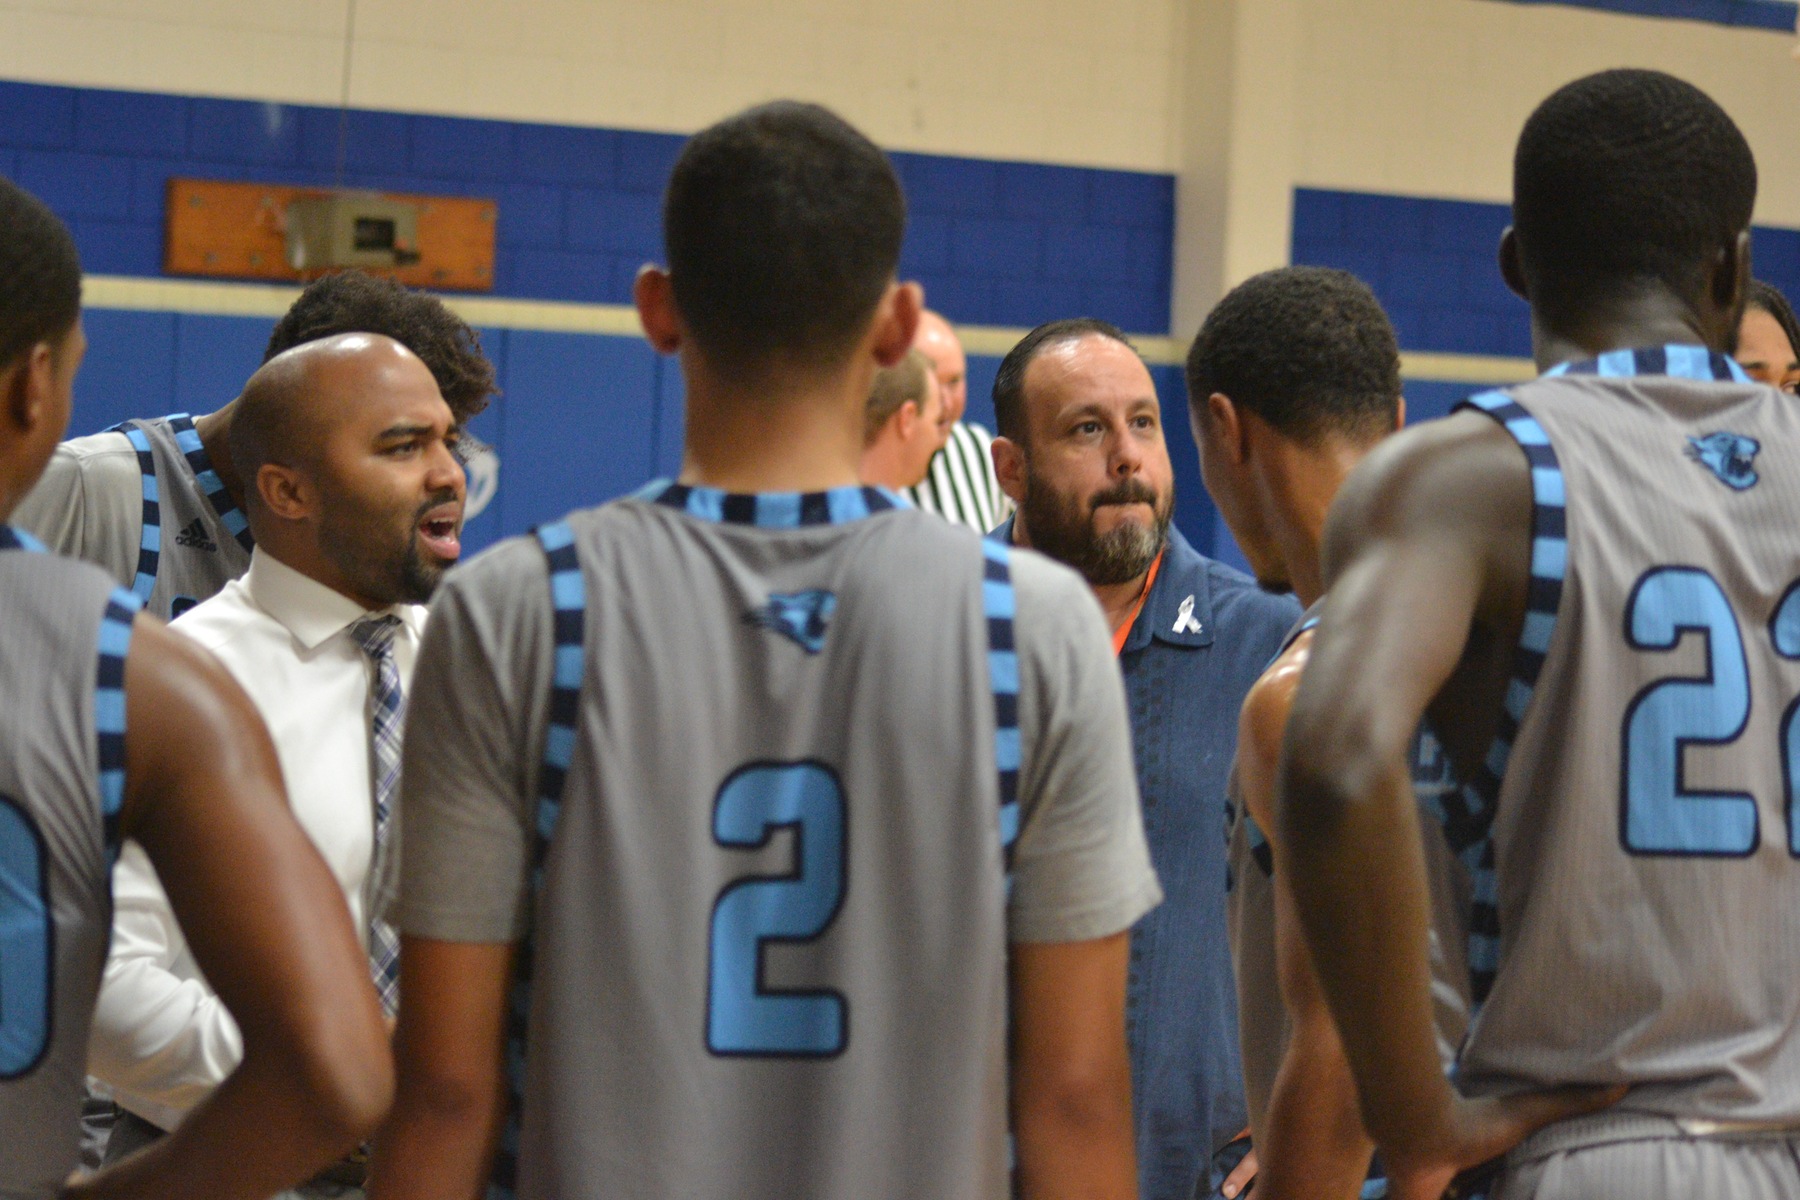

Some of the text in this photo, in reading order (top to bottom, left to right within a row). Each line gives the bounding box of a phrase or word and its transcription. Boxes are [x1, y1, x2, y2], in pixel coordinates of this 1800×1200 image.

[175, 535, 217, 552] adidas
[1618, 564, 1800, 860] 2
[706, 757, 850, 1060] 2
